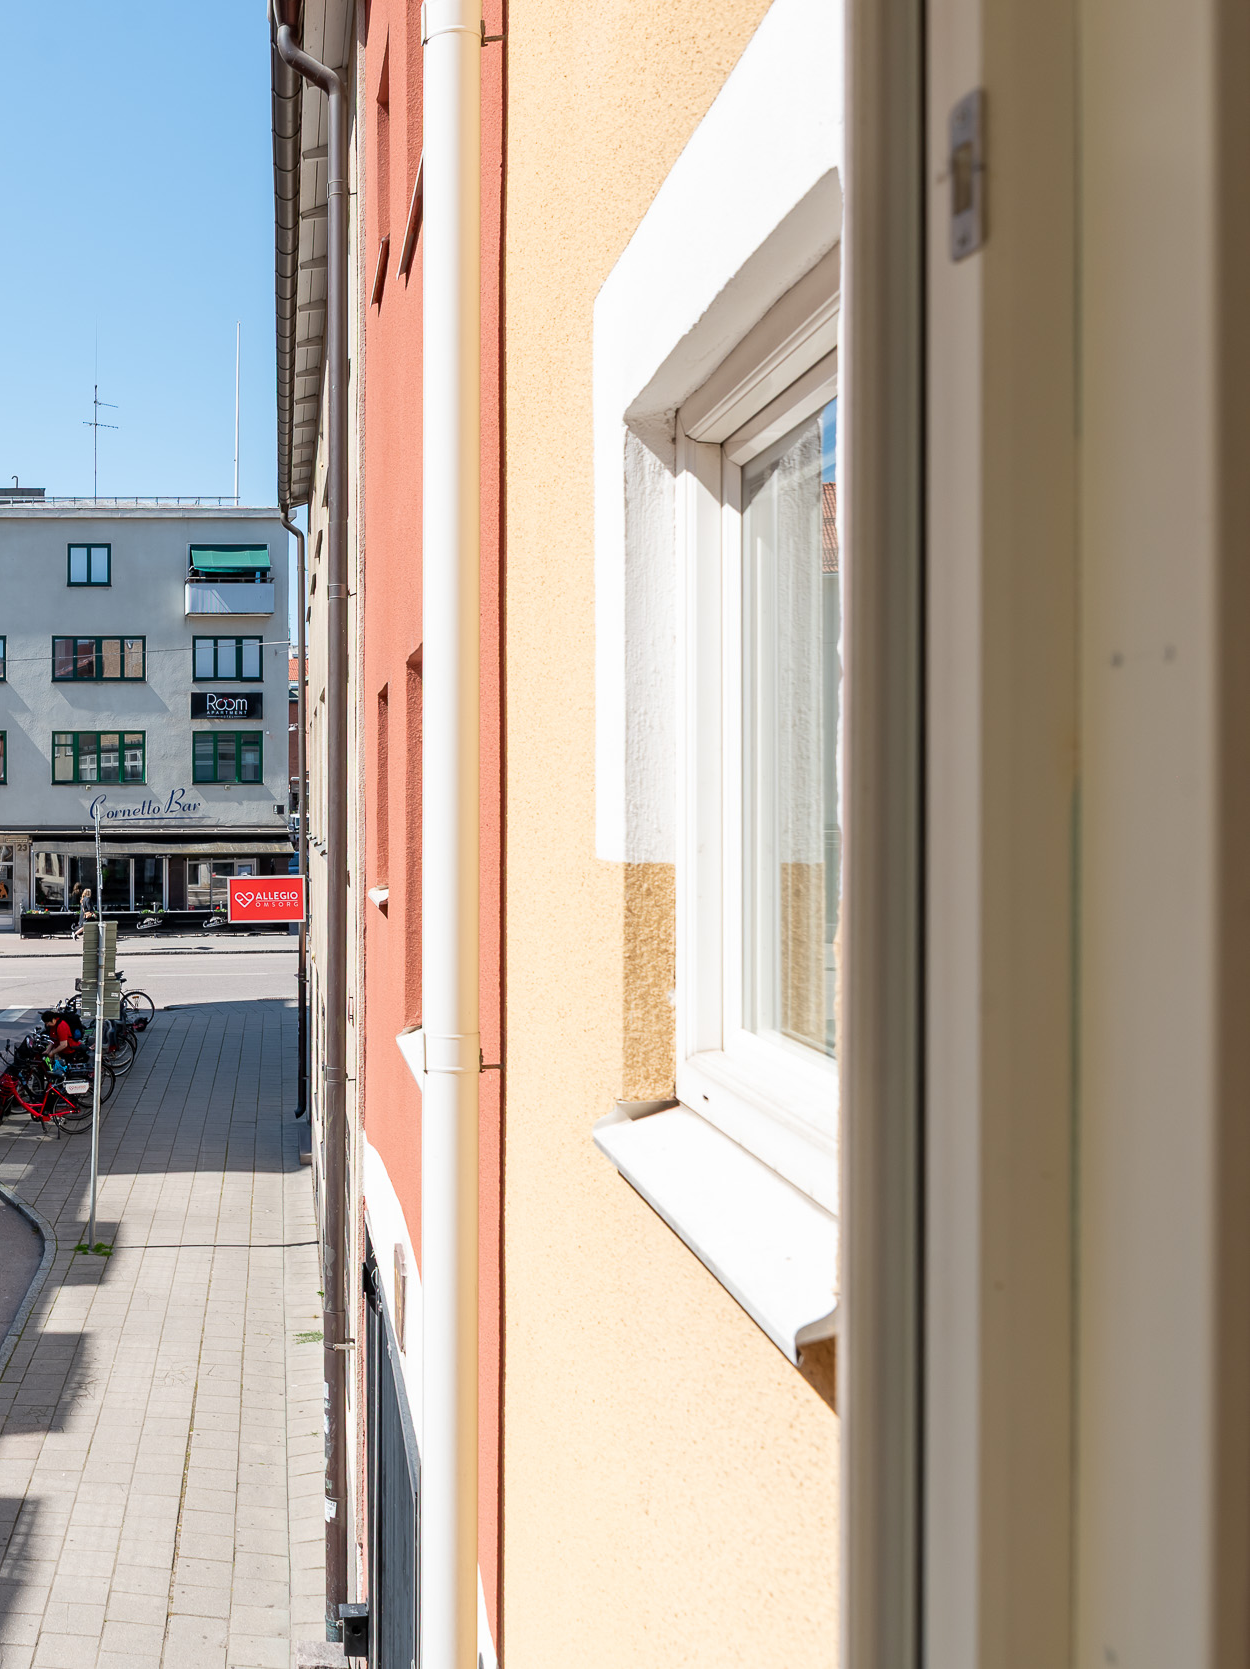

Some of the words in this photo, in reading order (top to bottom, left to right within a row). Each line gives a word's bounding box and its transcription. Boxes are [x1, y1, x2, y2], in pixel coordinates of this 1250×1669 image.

[206, 693, 248, 711] Room
[90, 794, 161, 820] Cornetto
[164, 788, 201, 814] Bar
[17, 843, 28, 852] 23
[255, 891, 299, 900] ALLEGIO
